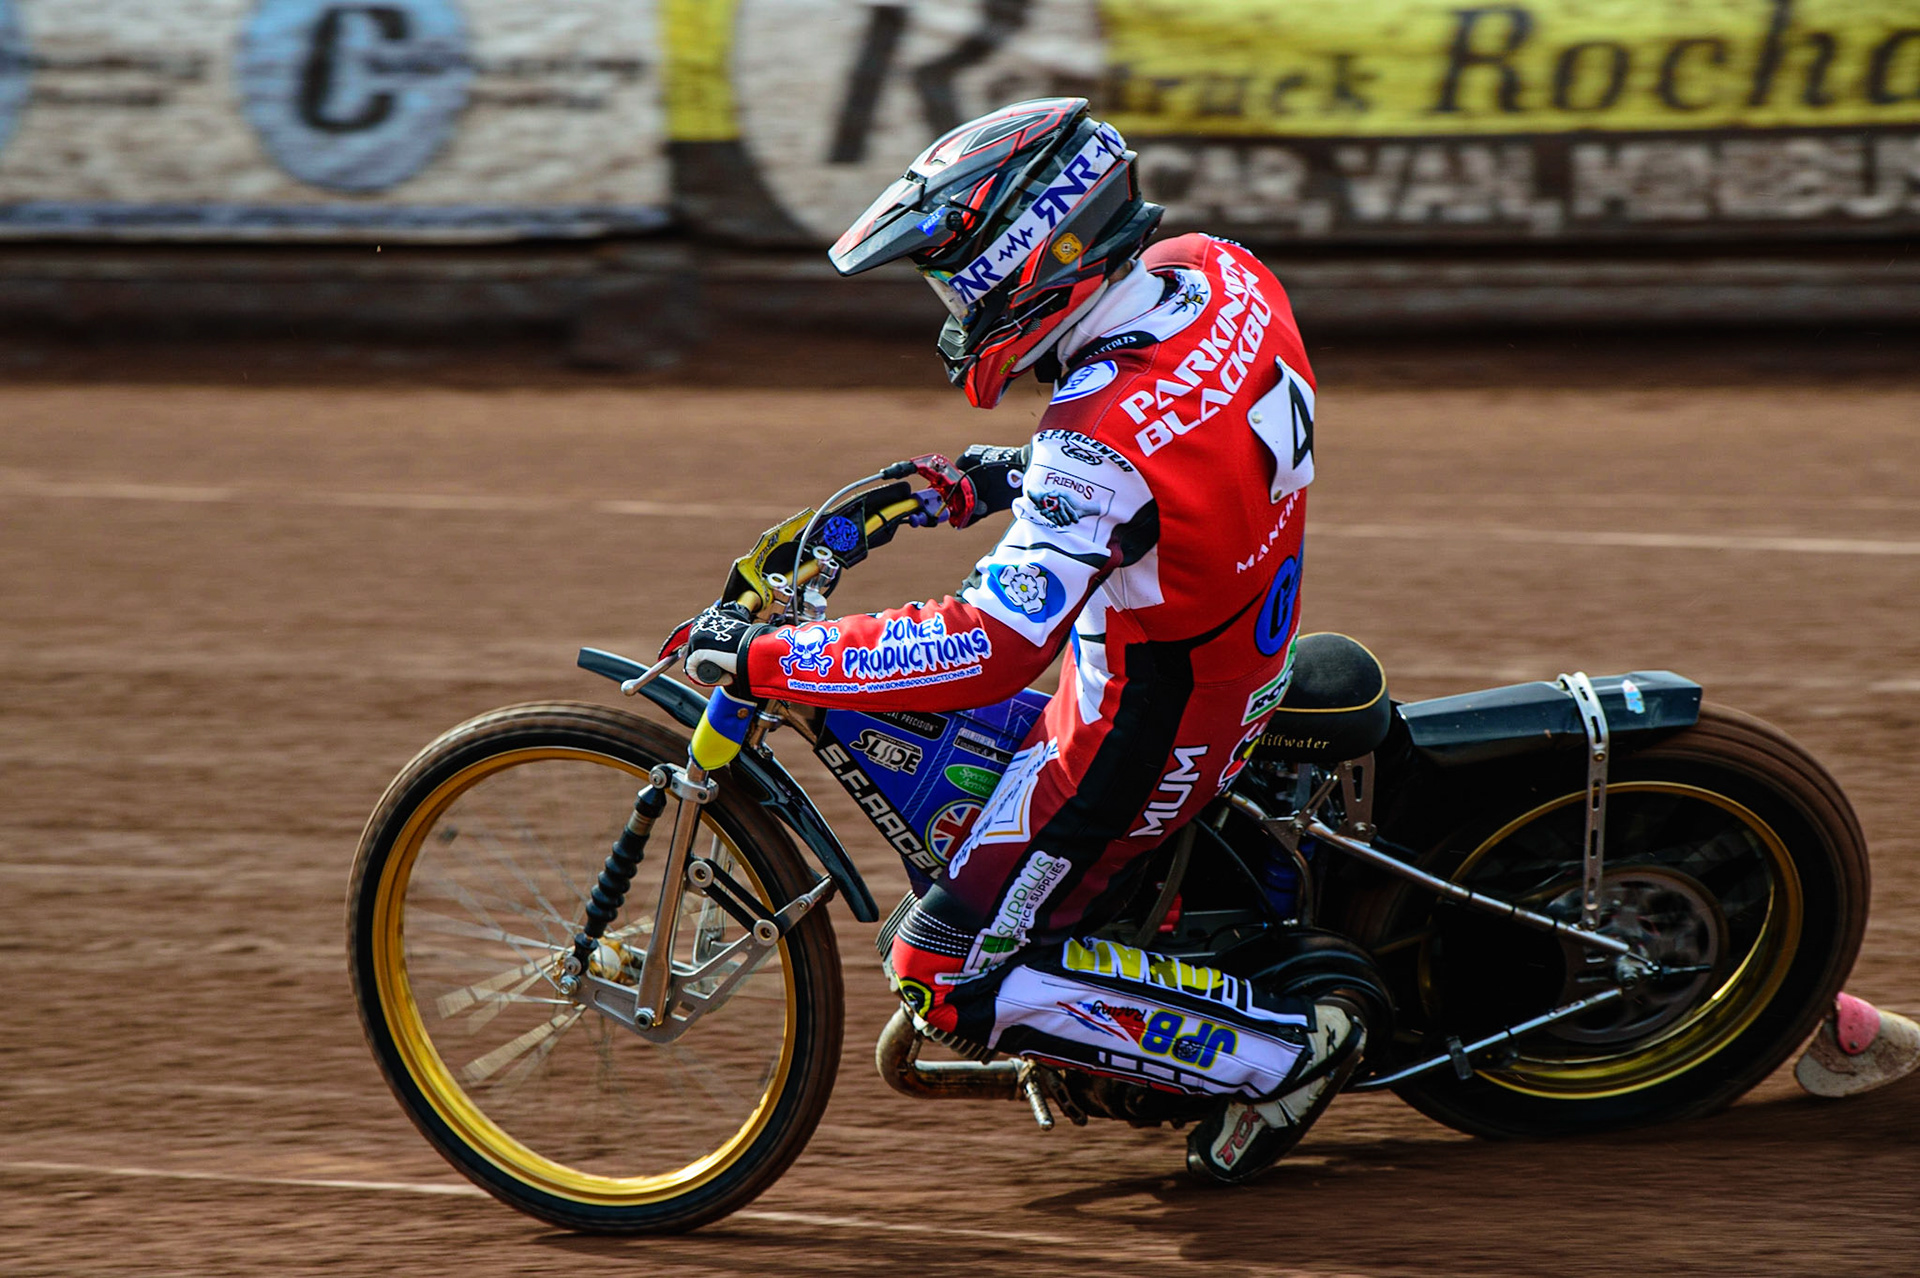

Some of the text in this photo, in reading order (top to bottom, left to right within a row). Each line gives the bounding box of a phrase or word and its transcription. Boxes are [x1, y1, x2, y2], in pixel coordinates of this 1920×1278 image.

[300, 5, 412, 133] C
[1119, 244, 1249, 425] PARKINSON
[1044, 472, 1095, 501] FRIENDS
[817, 682, 859, 693] CREATIONS
[844, 629, 990, 677] PRODUCTIONS
[1128, 745, 1209, 837] MUM
[997, 856, 1054, 938] SURPLUS
[1030, 861, 1065, 902] SUPPLIES
[1091, 1000, 1238, 1070] JPB Racing
